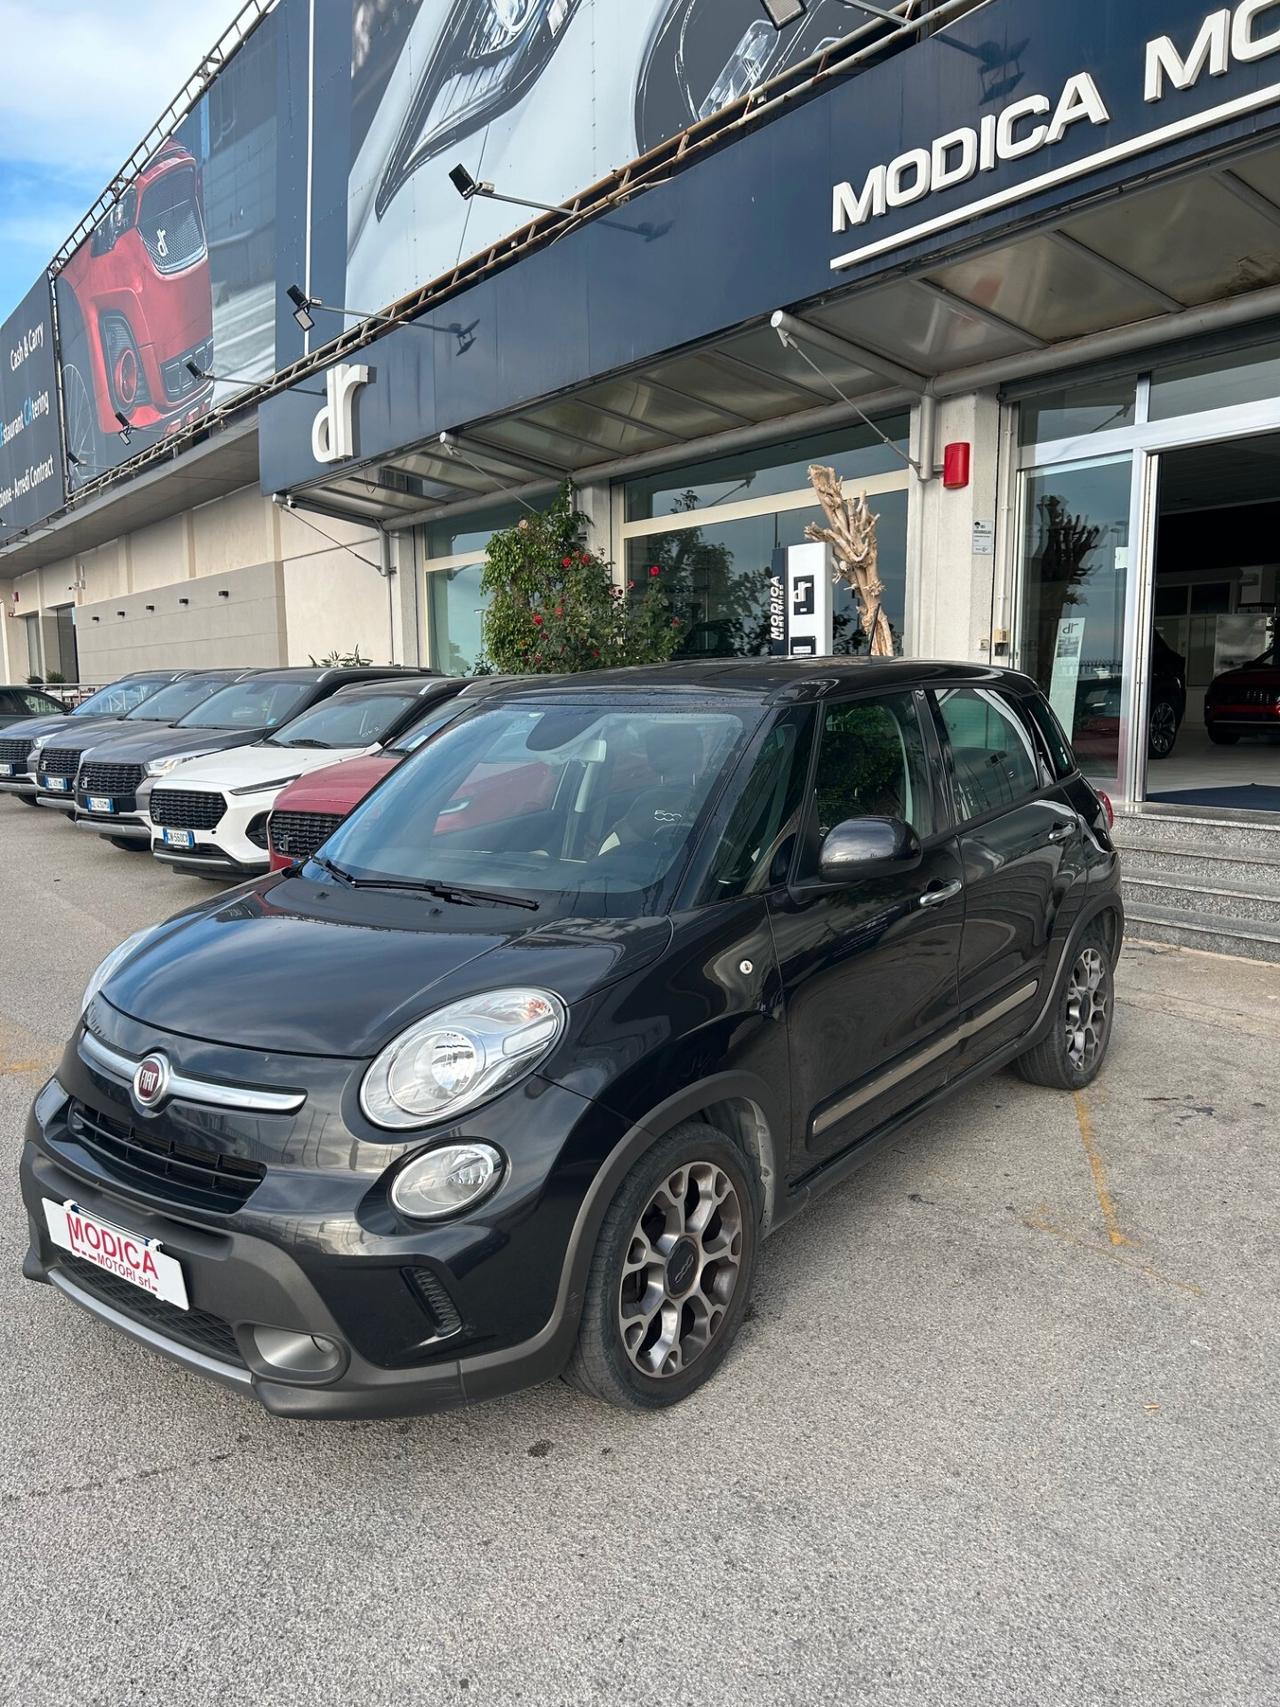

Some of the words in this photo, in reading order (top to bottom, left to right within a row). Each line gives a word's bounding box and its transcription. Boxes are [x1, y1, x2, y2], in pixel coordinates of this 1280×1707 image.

[832, 72, 1110, 233] MODICA
[11, 340, 25, 371] Cash
[24, 336, 29, 358] &
[28, 321, 44, 352] Carry
[311, 363, 368, 463] dr
[14, 469, 31, 499] Arredi
[30, 453, 54, 487] Contract
[770, 576, 782, 640] MODICA
[793, 581, 812, 603] dr
[1062, 622, 1079, 634] dr
[140, 1069, 158, 1092] FIAT
[66, 1212, 160, 1281] MODICA
[97, 1252, 136, 1281] MOTORI
